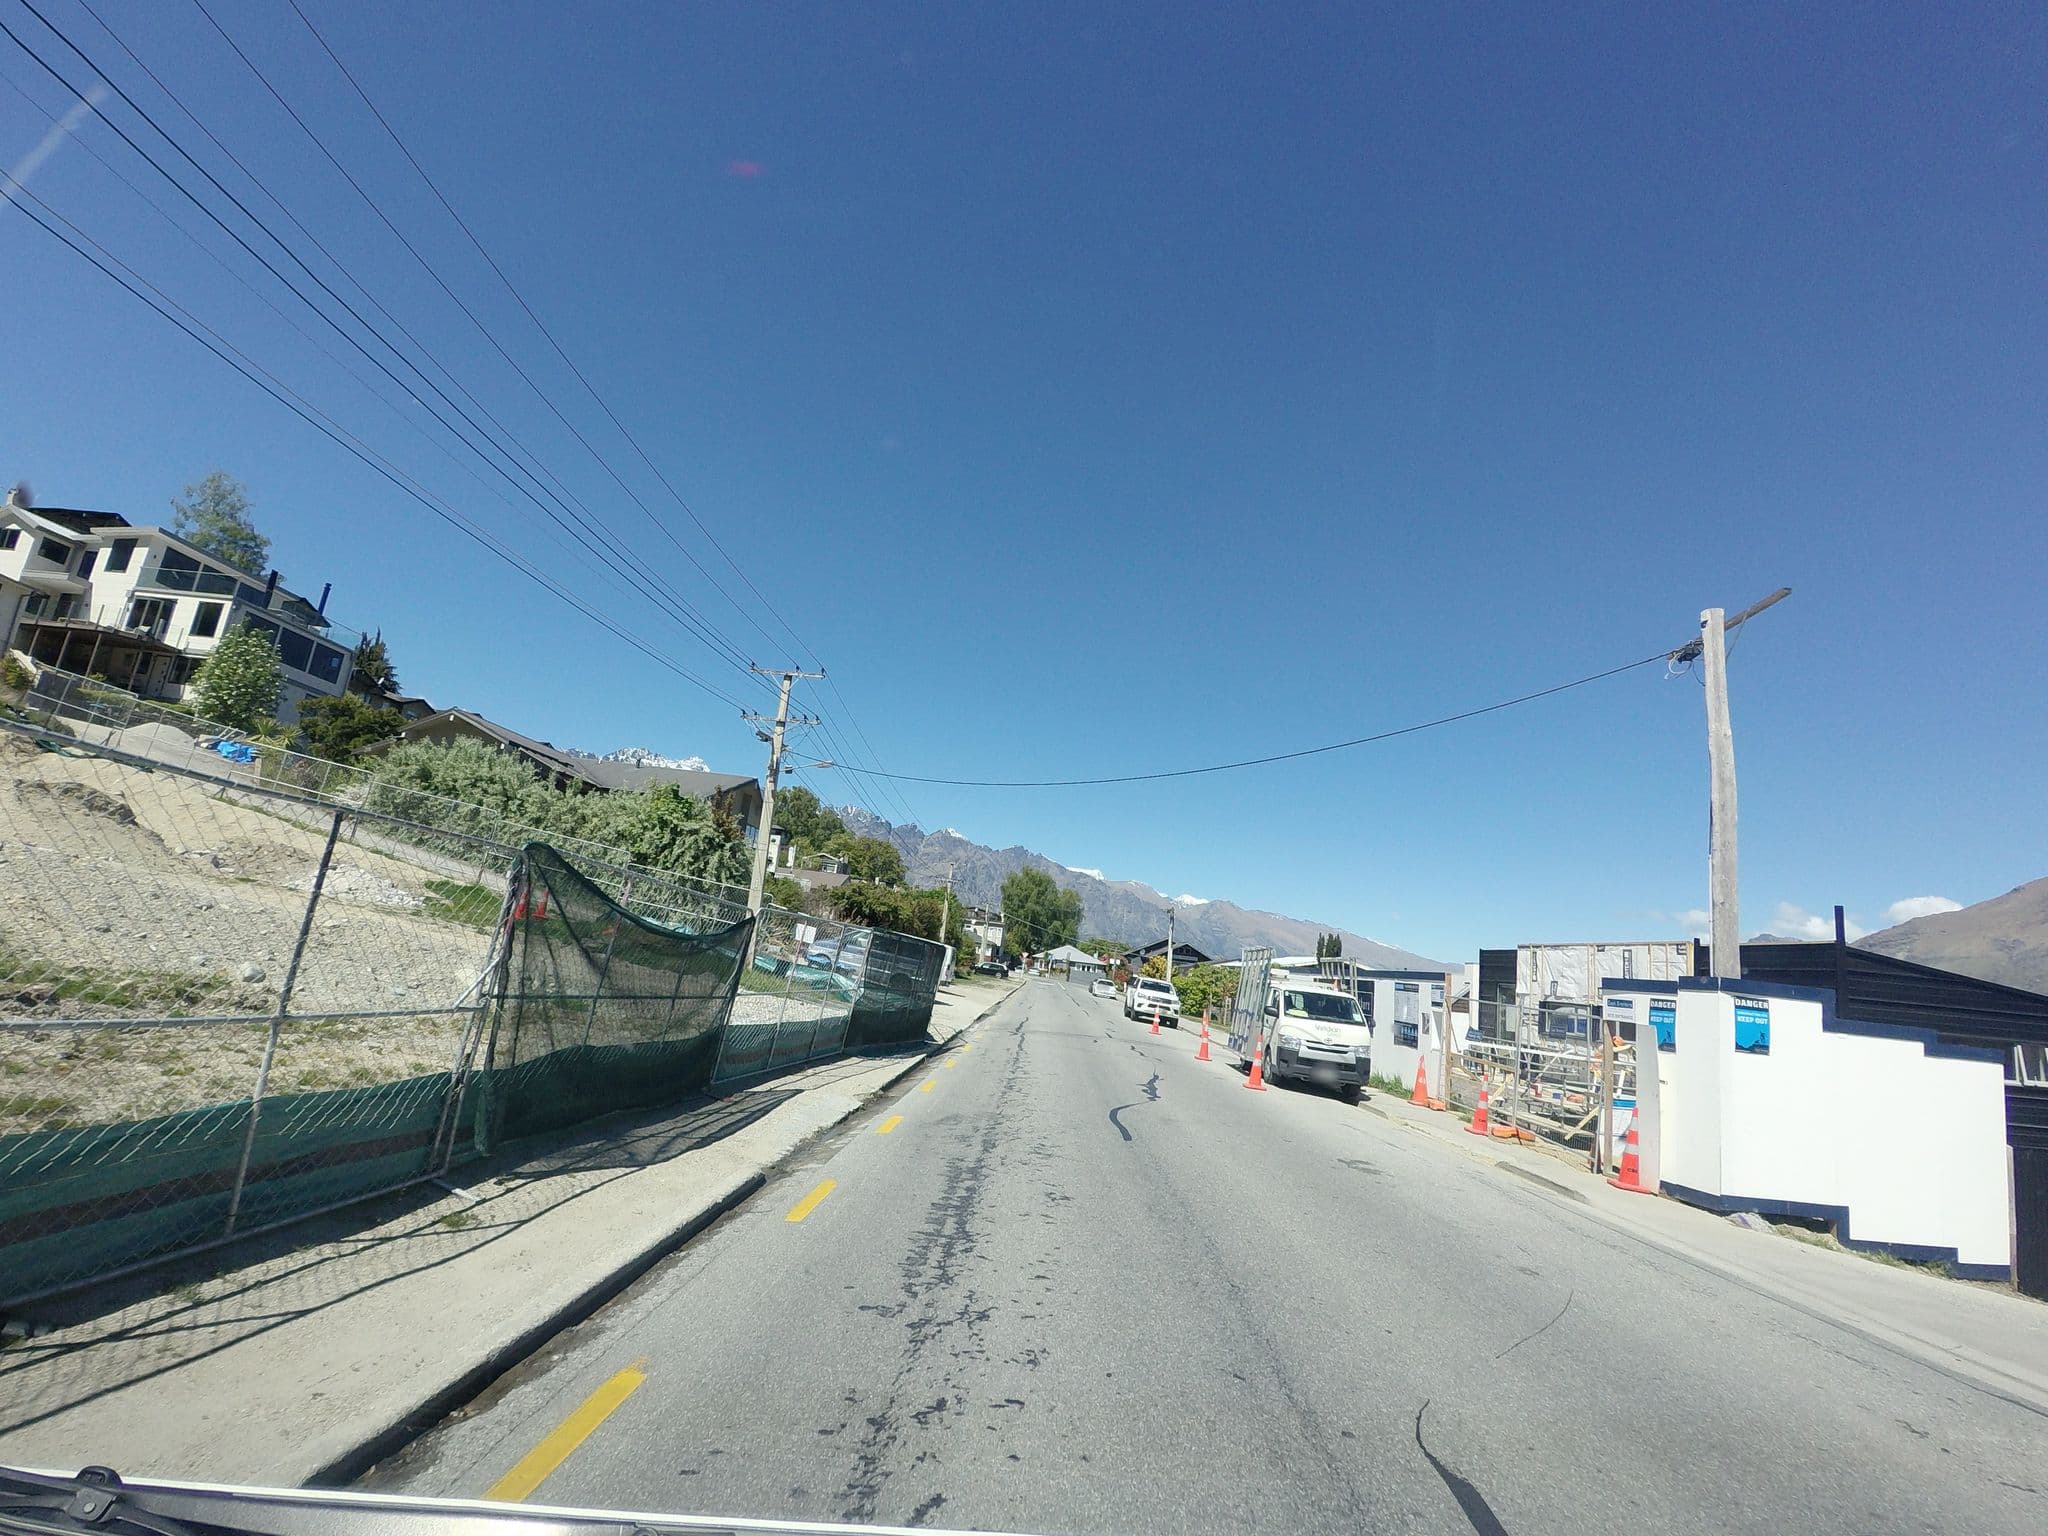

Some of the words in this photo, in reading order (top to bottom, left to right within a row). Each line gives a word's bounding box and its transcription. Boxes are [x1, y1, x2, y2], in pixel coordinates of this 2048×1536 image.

[1650, 1000, 1676, 1009] DANGER
[1735, 998, 1769, 1009] DANGER
[1737, 1015, 1754, 1023] KEEP
